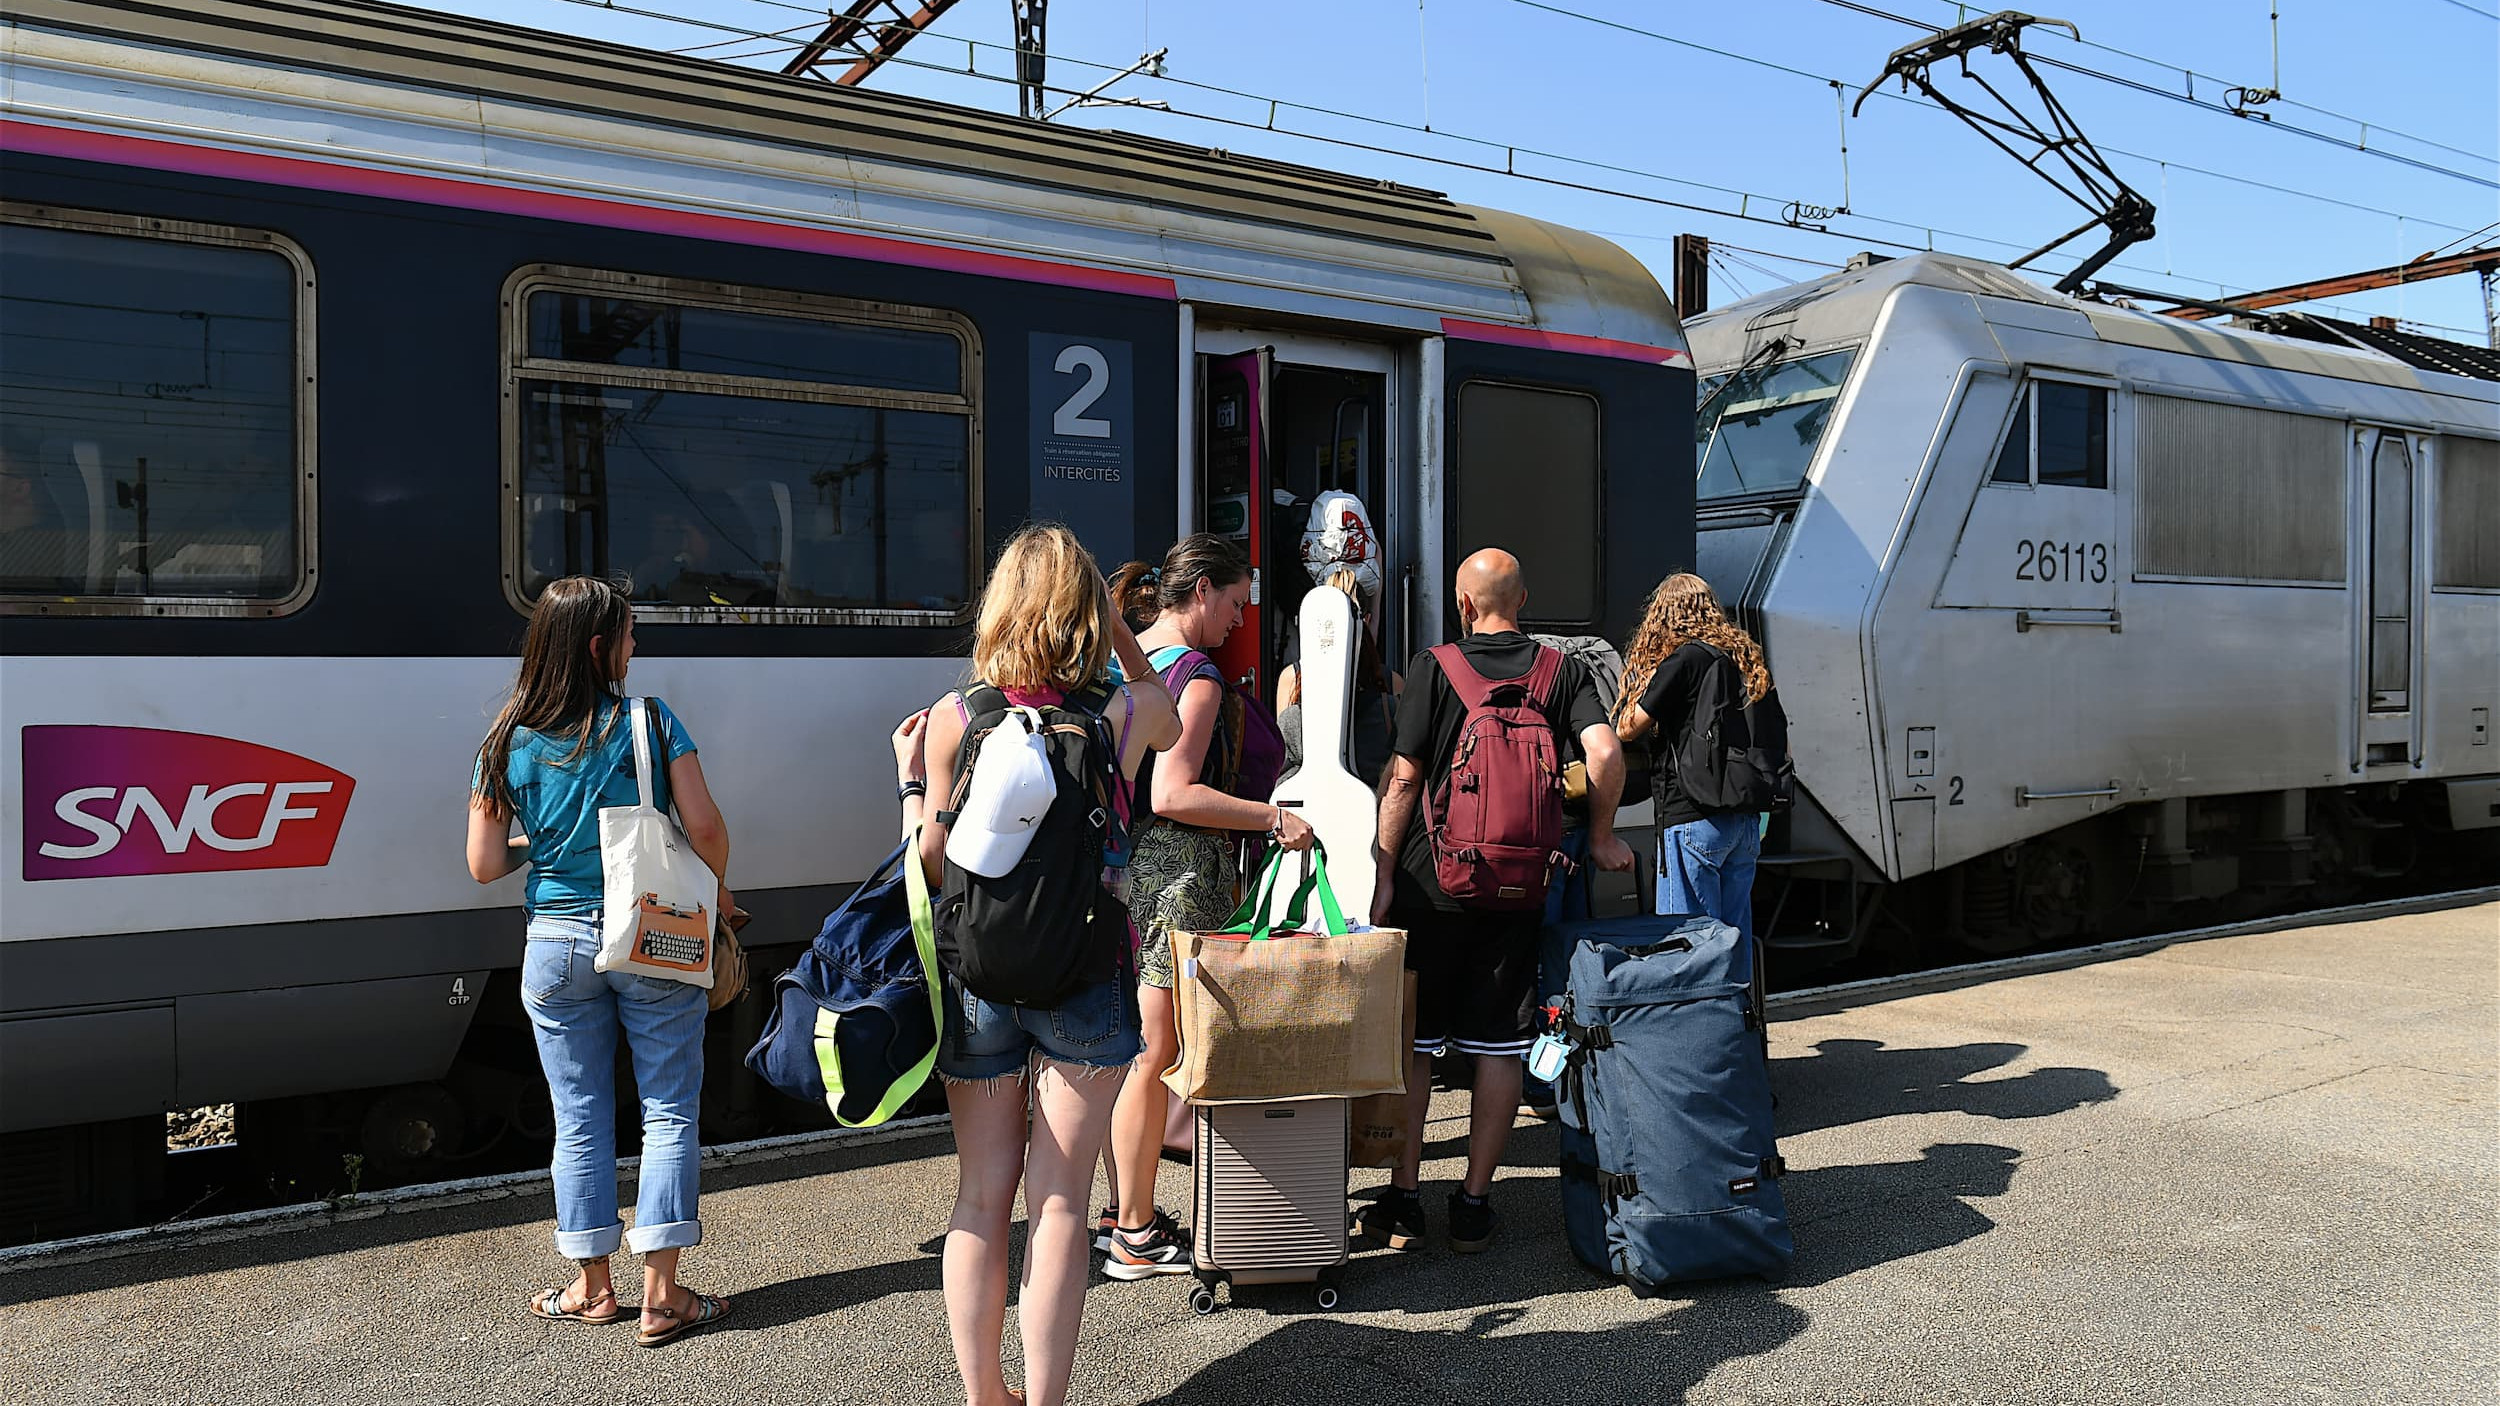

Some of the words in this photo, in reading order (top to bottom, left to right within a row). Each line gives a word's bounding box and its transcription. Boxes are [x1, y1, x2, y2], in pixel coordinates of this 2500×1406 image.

[1054, 345, 1111, 438] 2
[1045, 466, 1120, 482] INTERCITÉS
[2015, 539, 2108, 584] 26113
[1949, 776, 1964, 806] 2
[38, 781, 333, 859] SNCF
[448, 995, 471, 1005] GTP
[452, 977, 465, 995] 4
